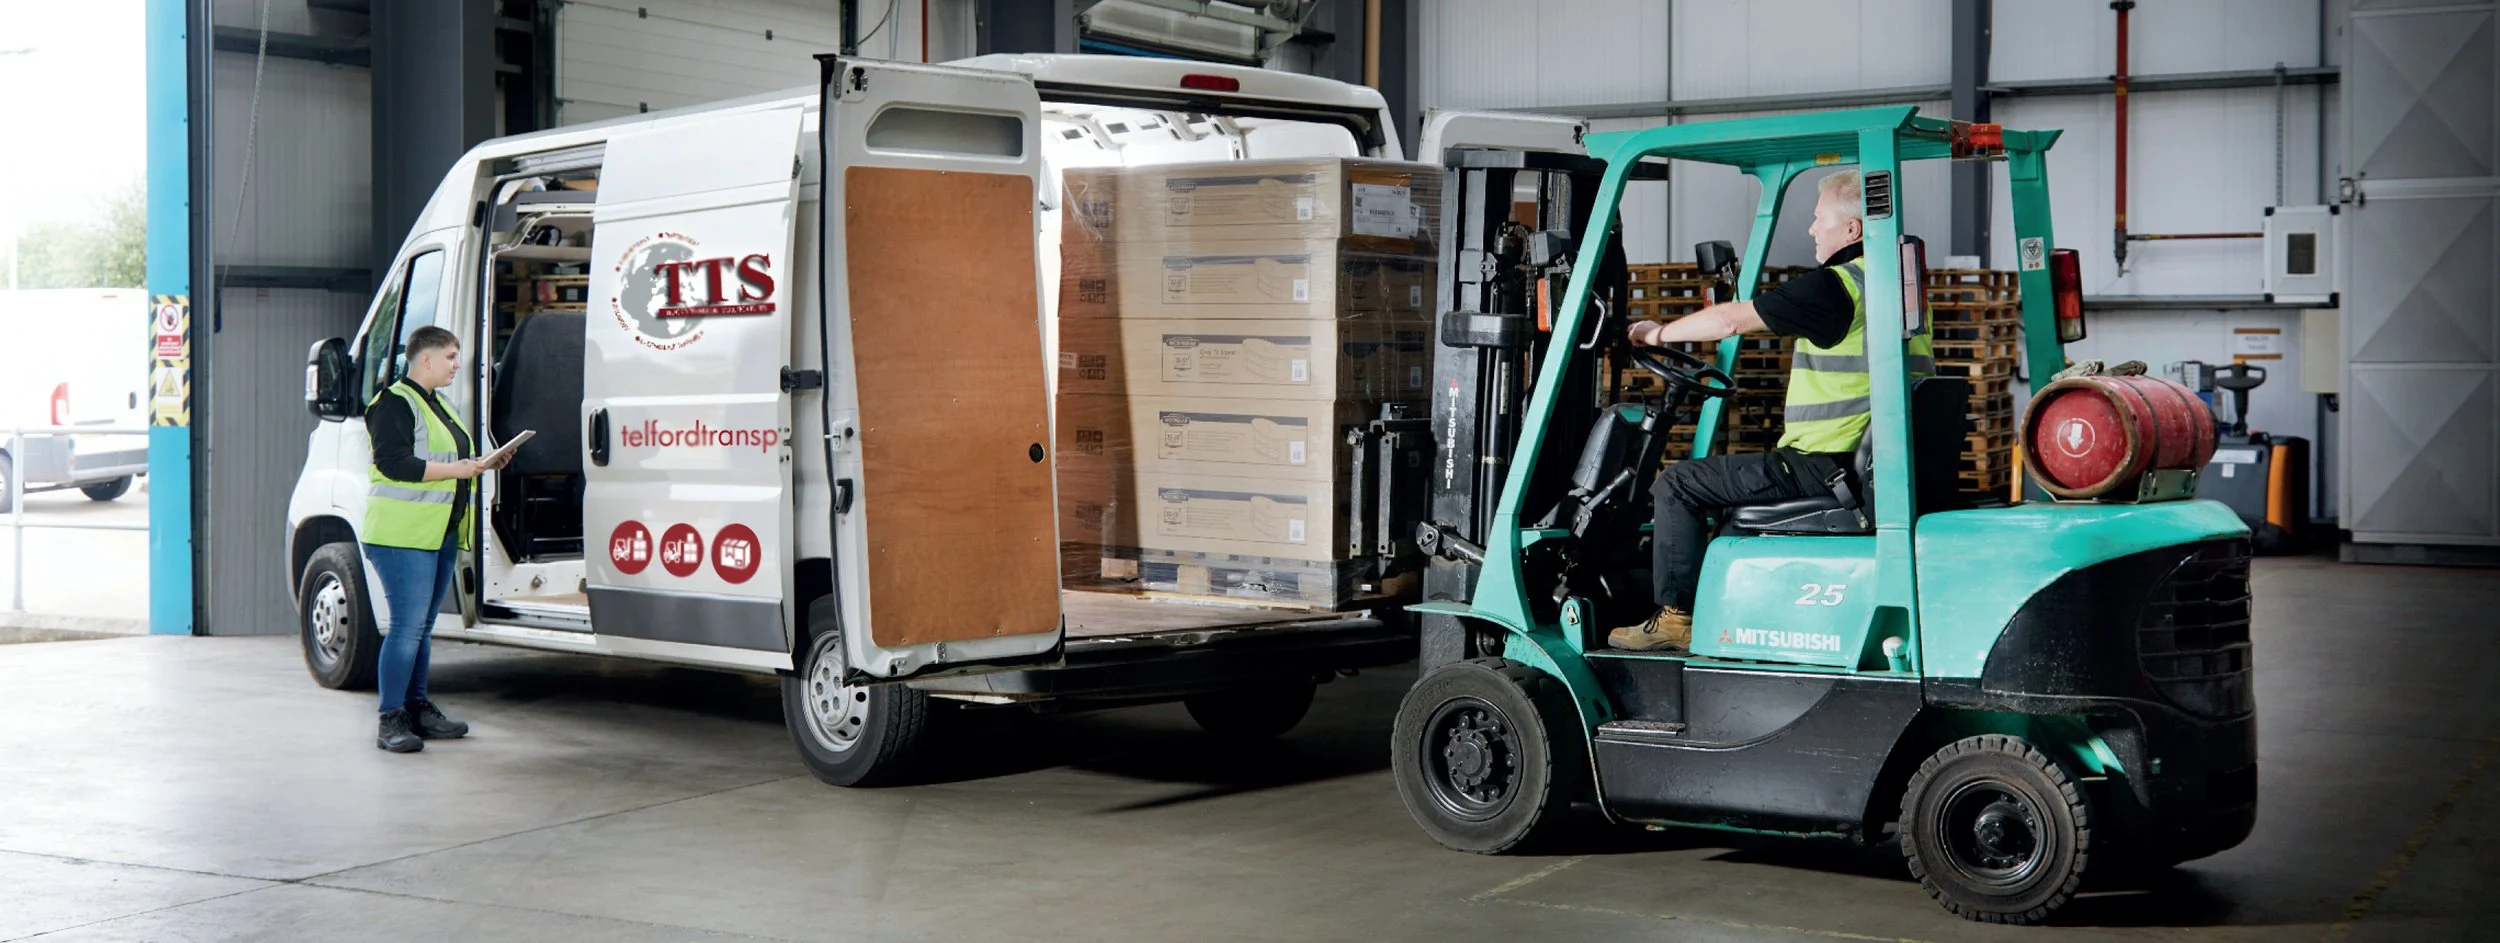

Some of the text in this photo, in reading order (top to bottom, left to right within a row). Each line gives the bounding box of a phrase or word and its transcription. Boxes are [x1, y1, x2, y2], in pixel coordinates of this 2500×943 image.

[656, 253, 775, 305] TTS
[621, 420, 778, 454] telfordtransp
[1445, 387, 1459, 489] MITSUBISHI
[1794, 583, 1847, 606] 25
[1736, 628, 1841, 651] MITSUBISHI
